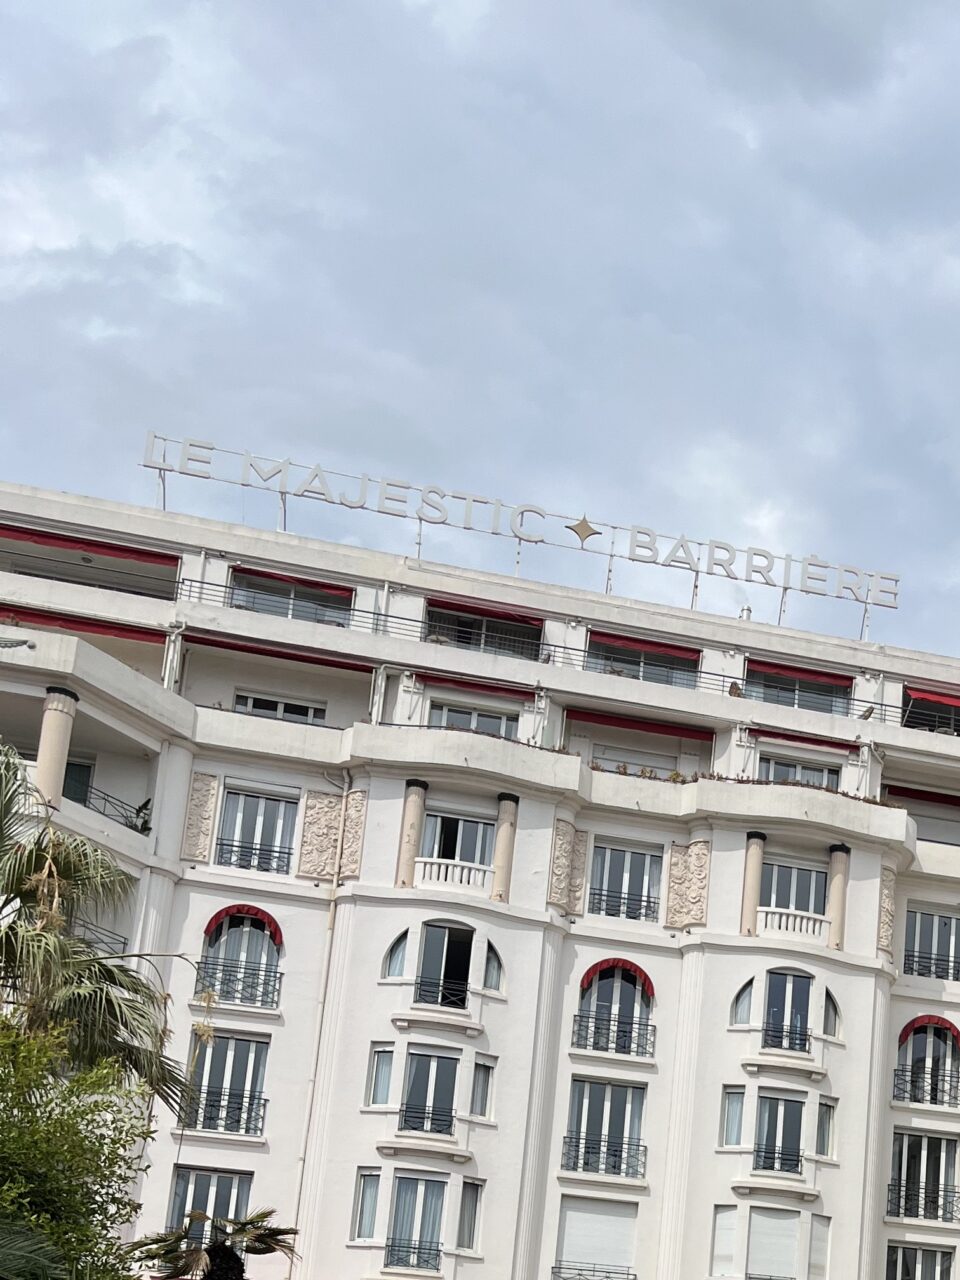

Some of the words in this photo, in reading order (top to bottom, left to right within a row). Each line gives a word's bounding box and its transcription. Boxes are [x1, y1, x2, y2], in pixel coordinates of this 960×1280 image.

[142, 430, 216, 480] LE
[241, 449, 547, 544] MAJESTIC
[628, 524, 900, 609] BARRIÈRE
